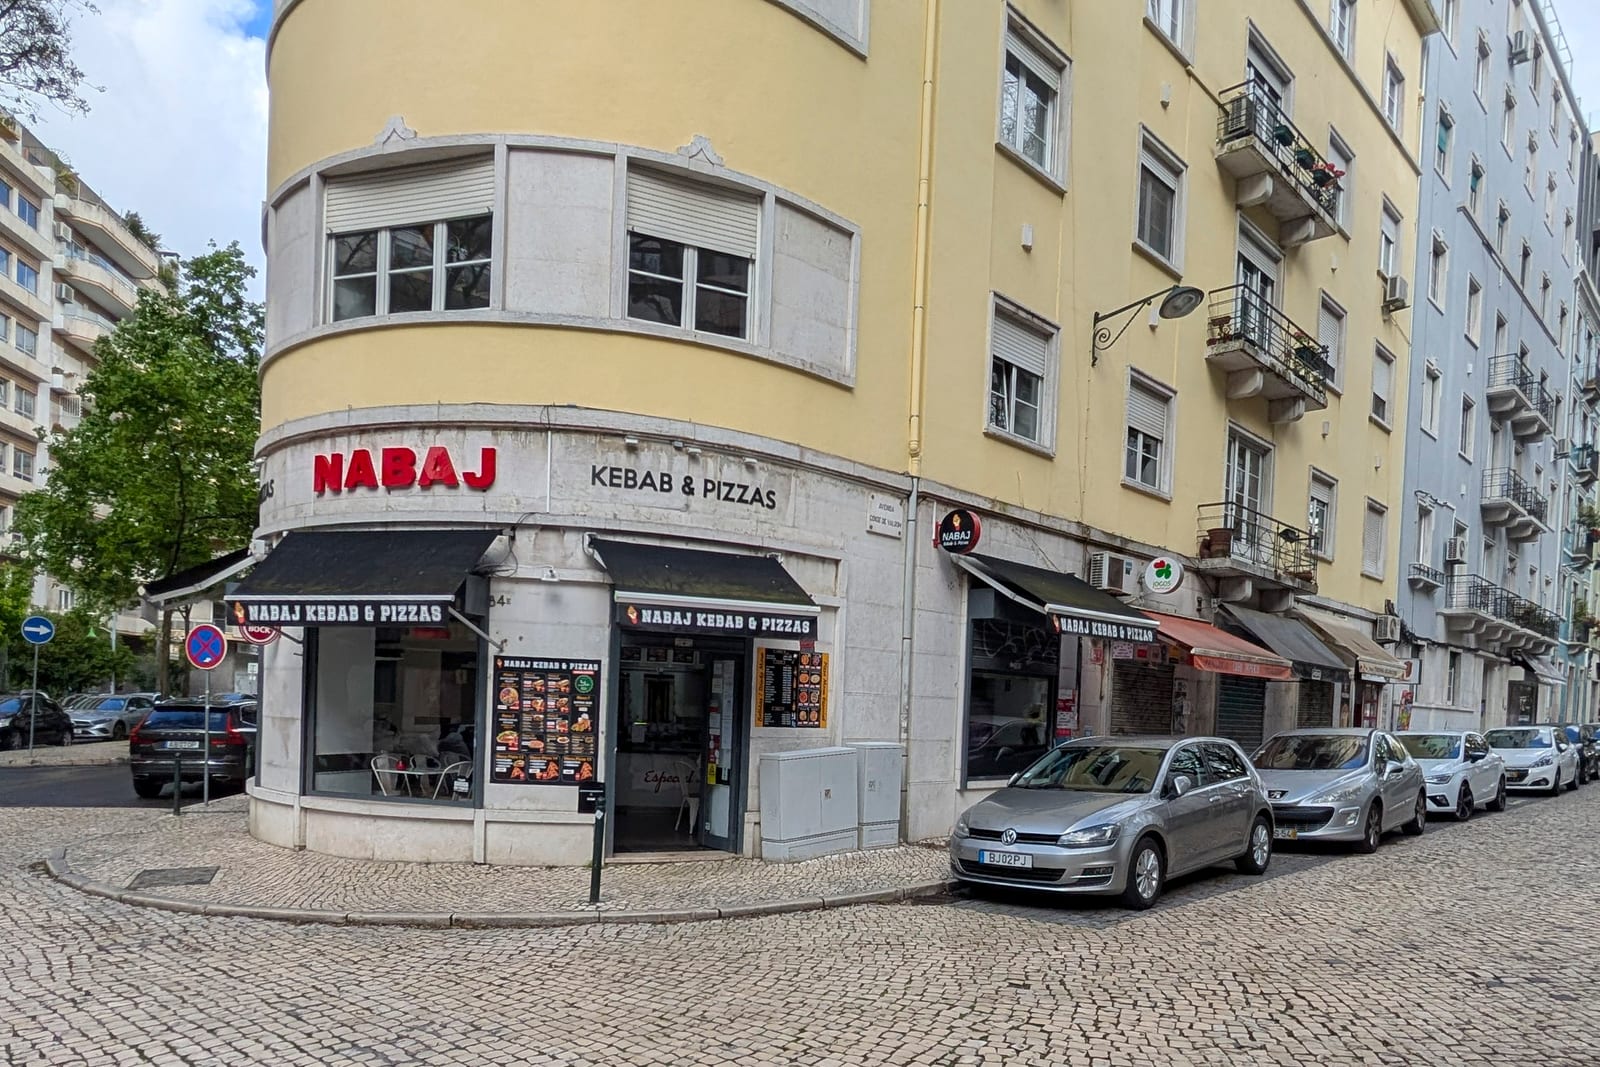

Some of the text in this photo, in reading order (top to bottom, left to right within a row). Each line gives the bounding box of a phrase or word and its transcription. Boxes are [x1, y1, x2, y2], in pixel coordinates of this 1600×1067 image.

[314, 447, 496, 494] NABAJ
[591, 464, 777, 510] KEBAB & PIZZAS
[942, 530, 971, 541] NABAJ
[248, 605, 442, 622] NABAJ KEBAB & PIZZAS
[641, 609, 810, 634] NABAJ KEBAB & PIZZAS
[1060, 617, 1153, 642] NABAJ KEBAB & PIZZAS
[503, 660, 599, 671] NABAJ KEBAB & PIZZAS
[988, 853, 1027, 866] BJ02PJ
